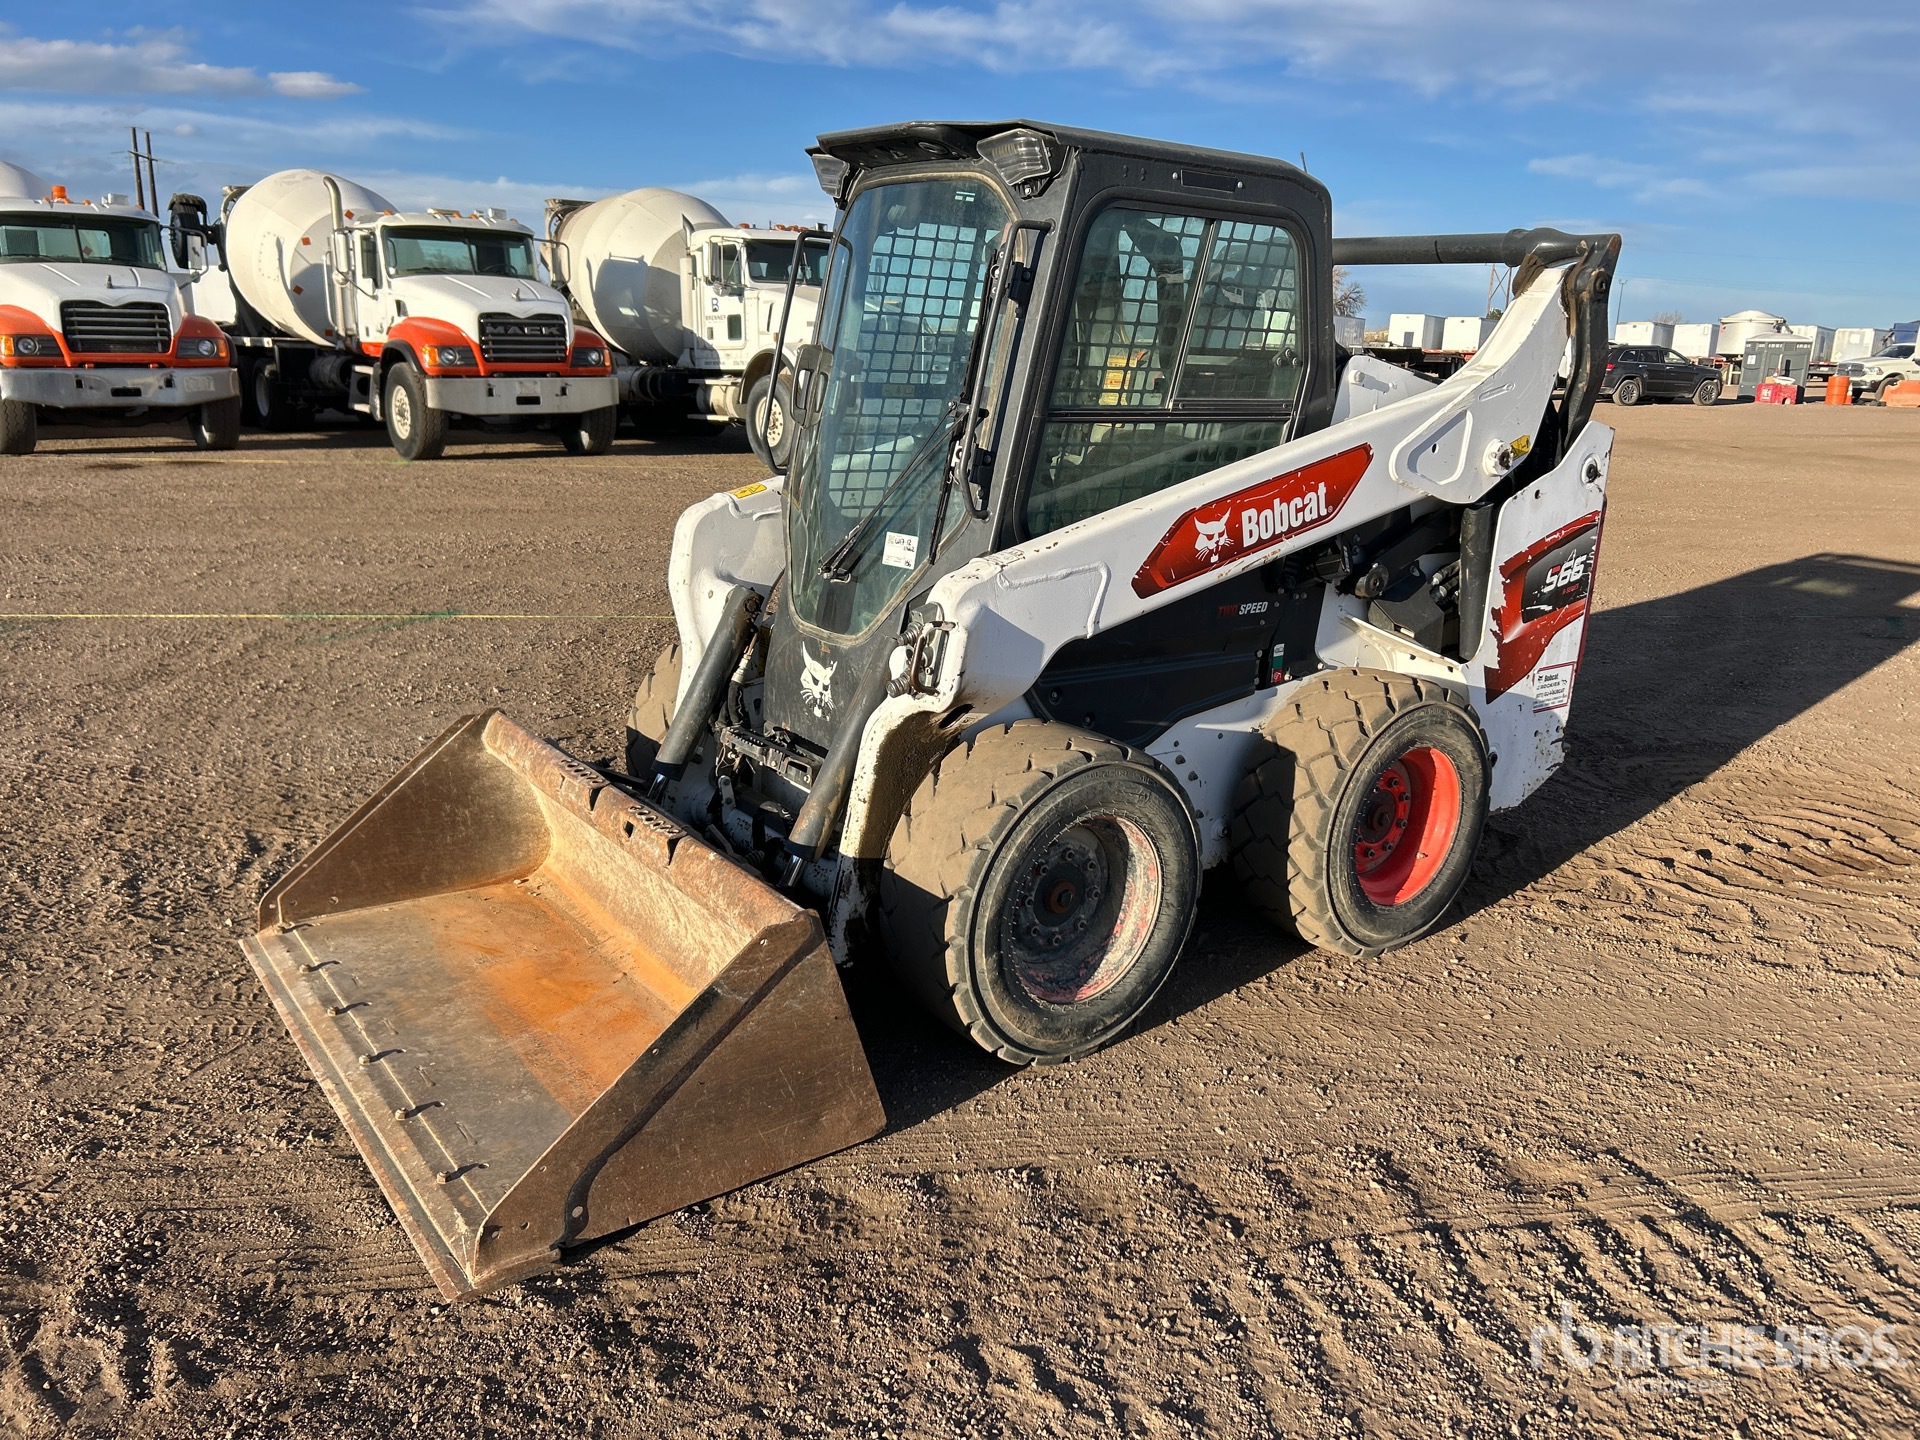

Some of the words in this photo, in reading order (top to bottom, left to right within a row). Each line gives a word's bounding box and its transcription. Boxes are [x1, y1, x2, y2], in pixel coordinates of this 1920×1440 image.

[485, 325, 560, 334] MACK
[1241, 481, 1327, 547] Bobcat
[1218, 604, 1238, 616] TWO
[1239, 601, 1268, 615] SPEED
